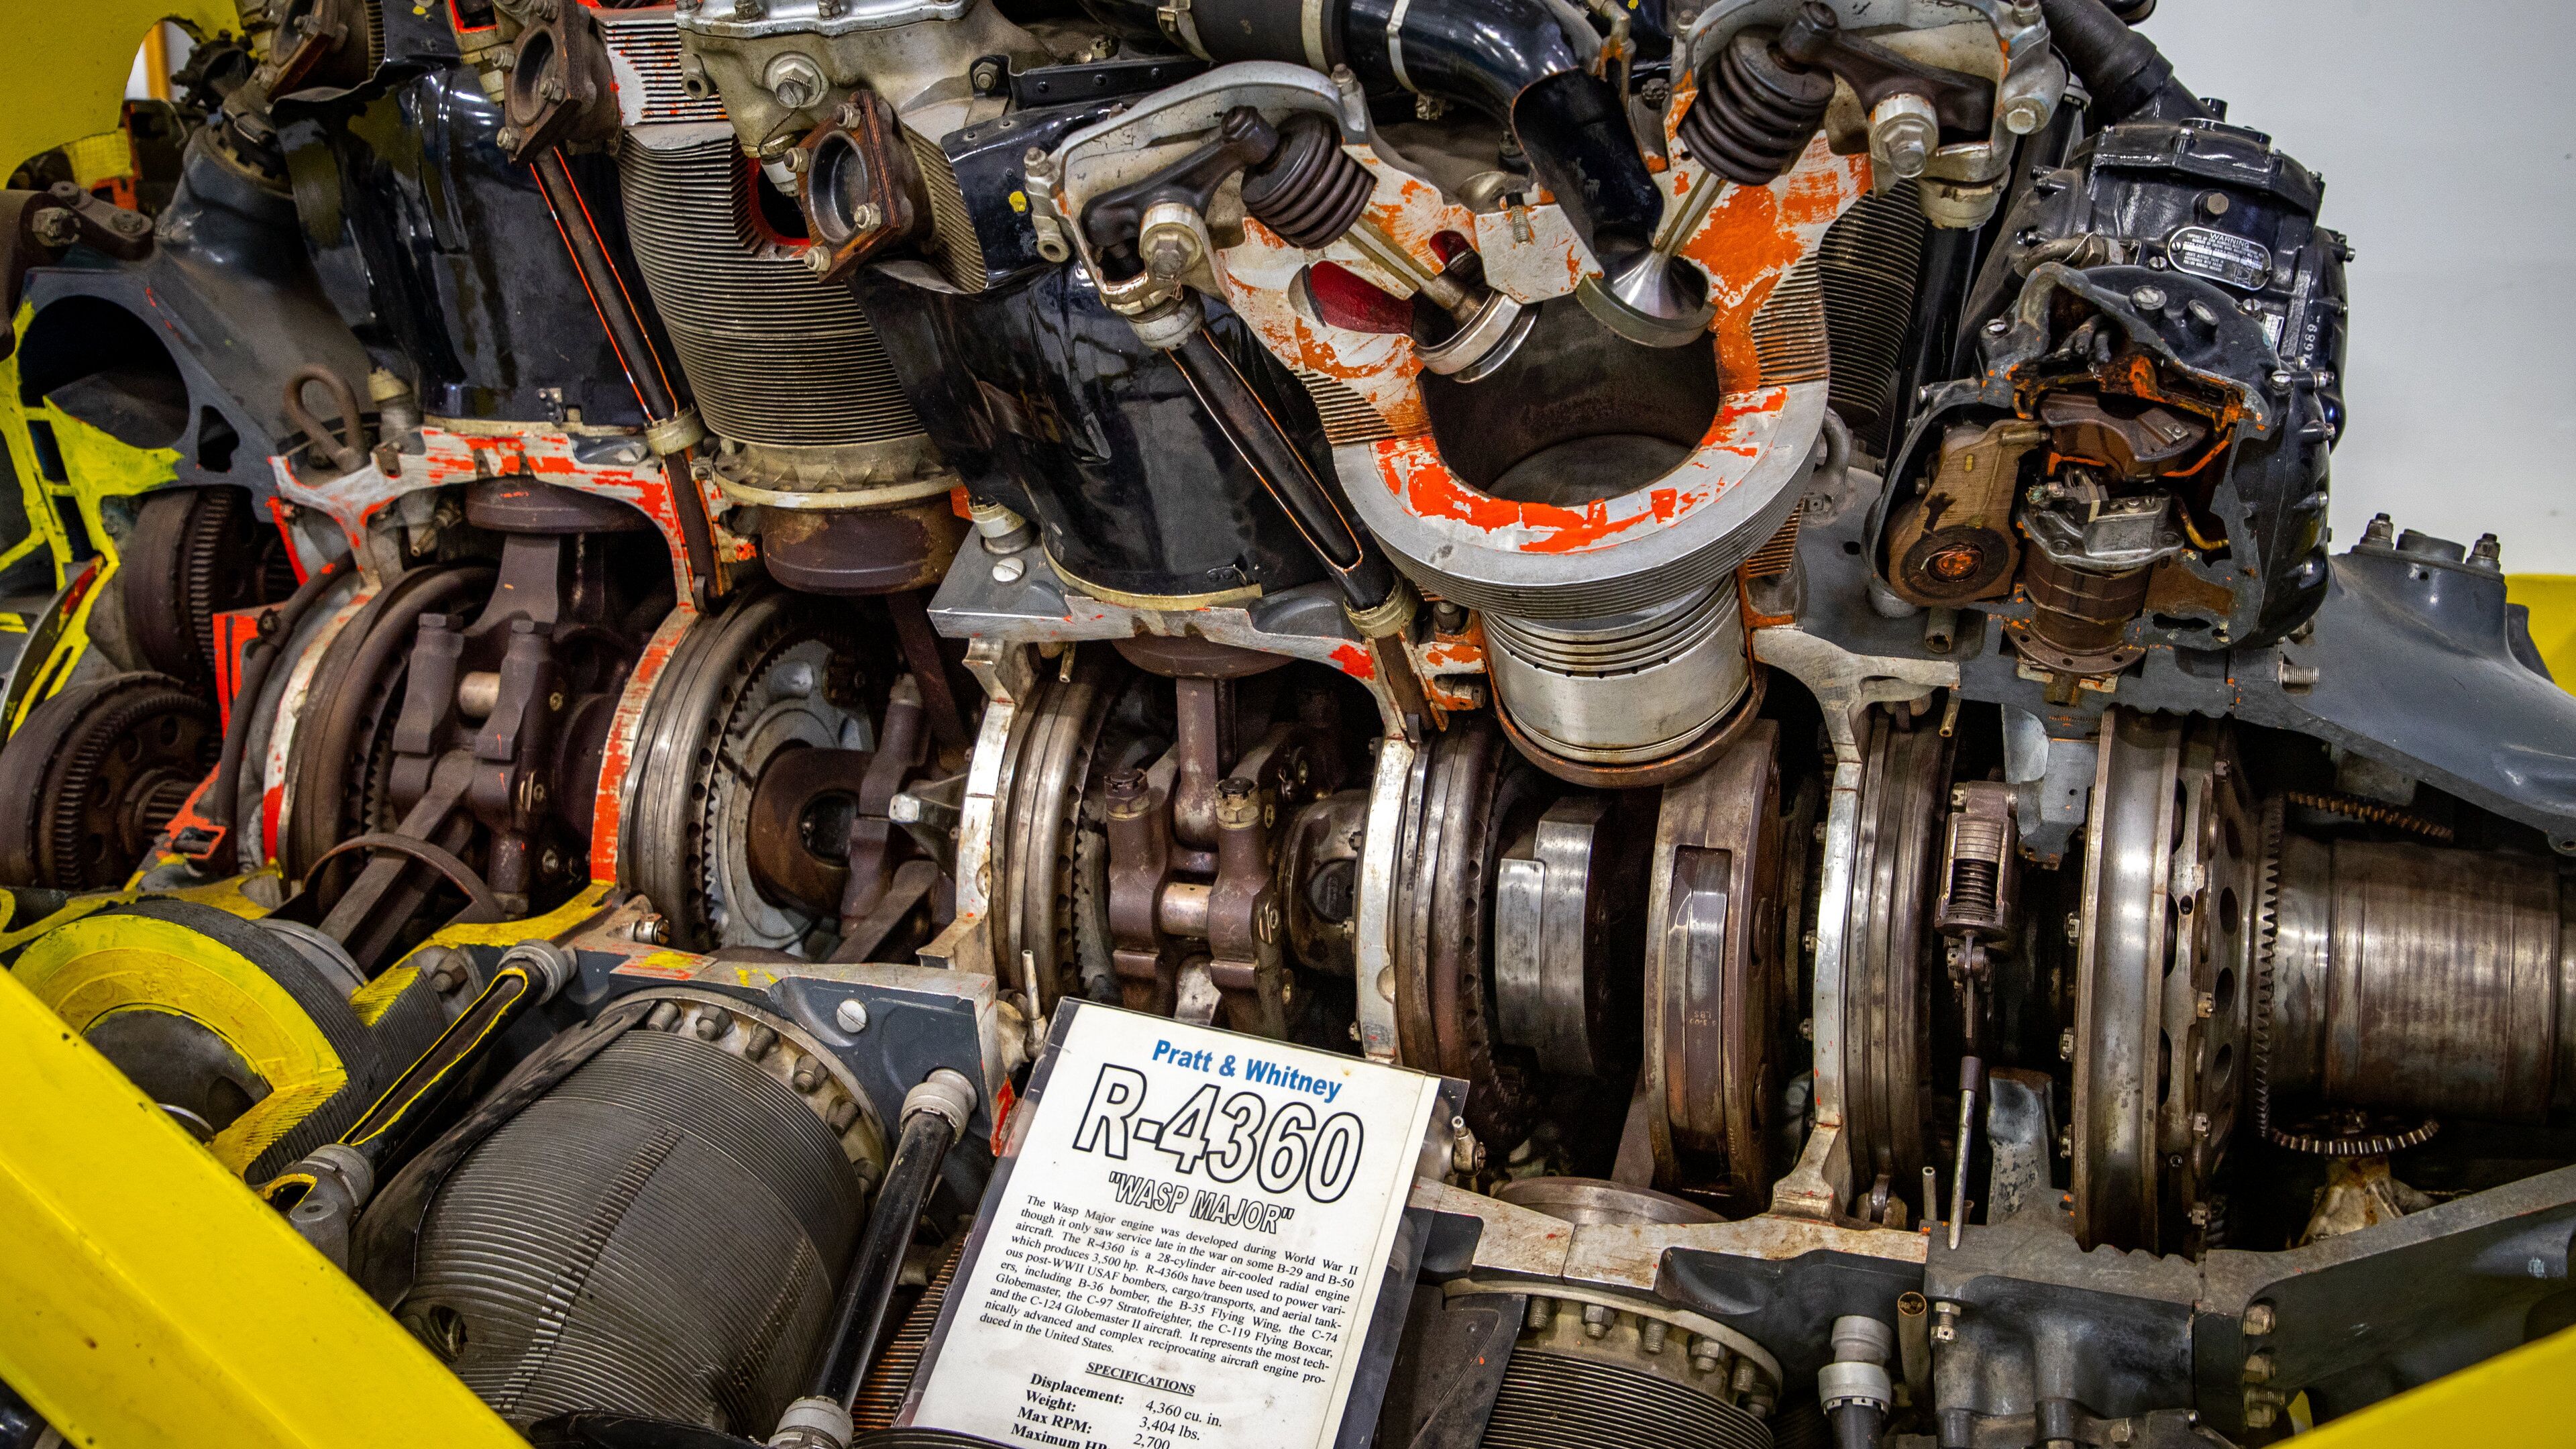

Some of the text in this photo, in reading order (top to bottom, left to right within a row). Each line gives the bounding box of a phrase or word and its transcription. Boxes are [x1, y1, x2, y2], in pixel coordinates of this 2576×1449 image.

[2209, 232, 2250, 248] WARNING
[1152, 1039, 1342, 1104] Pratt & Whitney
[1071, 1063, 1364, 1204] R-4360
[1028, 1195, 1358, 1275] The Wasp Major engine was developed during World War II
[1108, 1171, 1295, 1235] "WASP MAJOR"
[1012, 1235, 1346, 1316] which produces 3,500 hp. R-4360s have been used to power vari-
[1016, 1222, 1053, 1238] aircraft.
[1063, 1232, 1081, 1244] The
[1087, 1237, 1125, 1253] R-4360
[1130, 1246, 1139, 1256] is
[1157, 1252, 1216, 1273] 28-cylinder
[1221, 1267, 1274, 1285] air-cooled
[1279, 1281, 1309, 1293] radial
[1315, 1289, 1350, 1302] engine
[1020, 1208, 1354, 1289] though it only saw service late in the war on some B-29 and B-50
[989, 1288, 1330, 1370] and the C-124 Globemaster II aircraft. It represents the most tech-
[996, 1273, 1333, 1358] Globemaster, the C-97 Stratofreighter, the C-119 Flying Boxcar,
[1000, 1262, 1338, 1343] ers, including B-36 bomber, the B-35 Flying Wing, the C-74
[1006, 1249, 1342, 1329] ous post-WWII USAF bombers, cargo/transports, and aerial tank-
[979, 1313, 1114, 1352] duced in the United States.
[985, 1300, 1326, 1383] nically advanced and complex reciprocating aircraft engine pro-
[1026, 1389, 1199, 1441] Weight: 3,404 lbs.
[1030, 1373, 1222, 1428] Displacement: 4,360 cu. in.
[1086, 1362, 1196, 1395] SPECIFICATIONS
[1010, 1423, 1080, 1449] Maximum
[1017, 1406, 1171, 1449] Max RPM: 2,700
